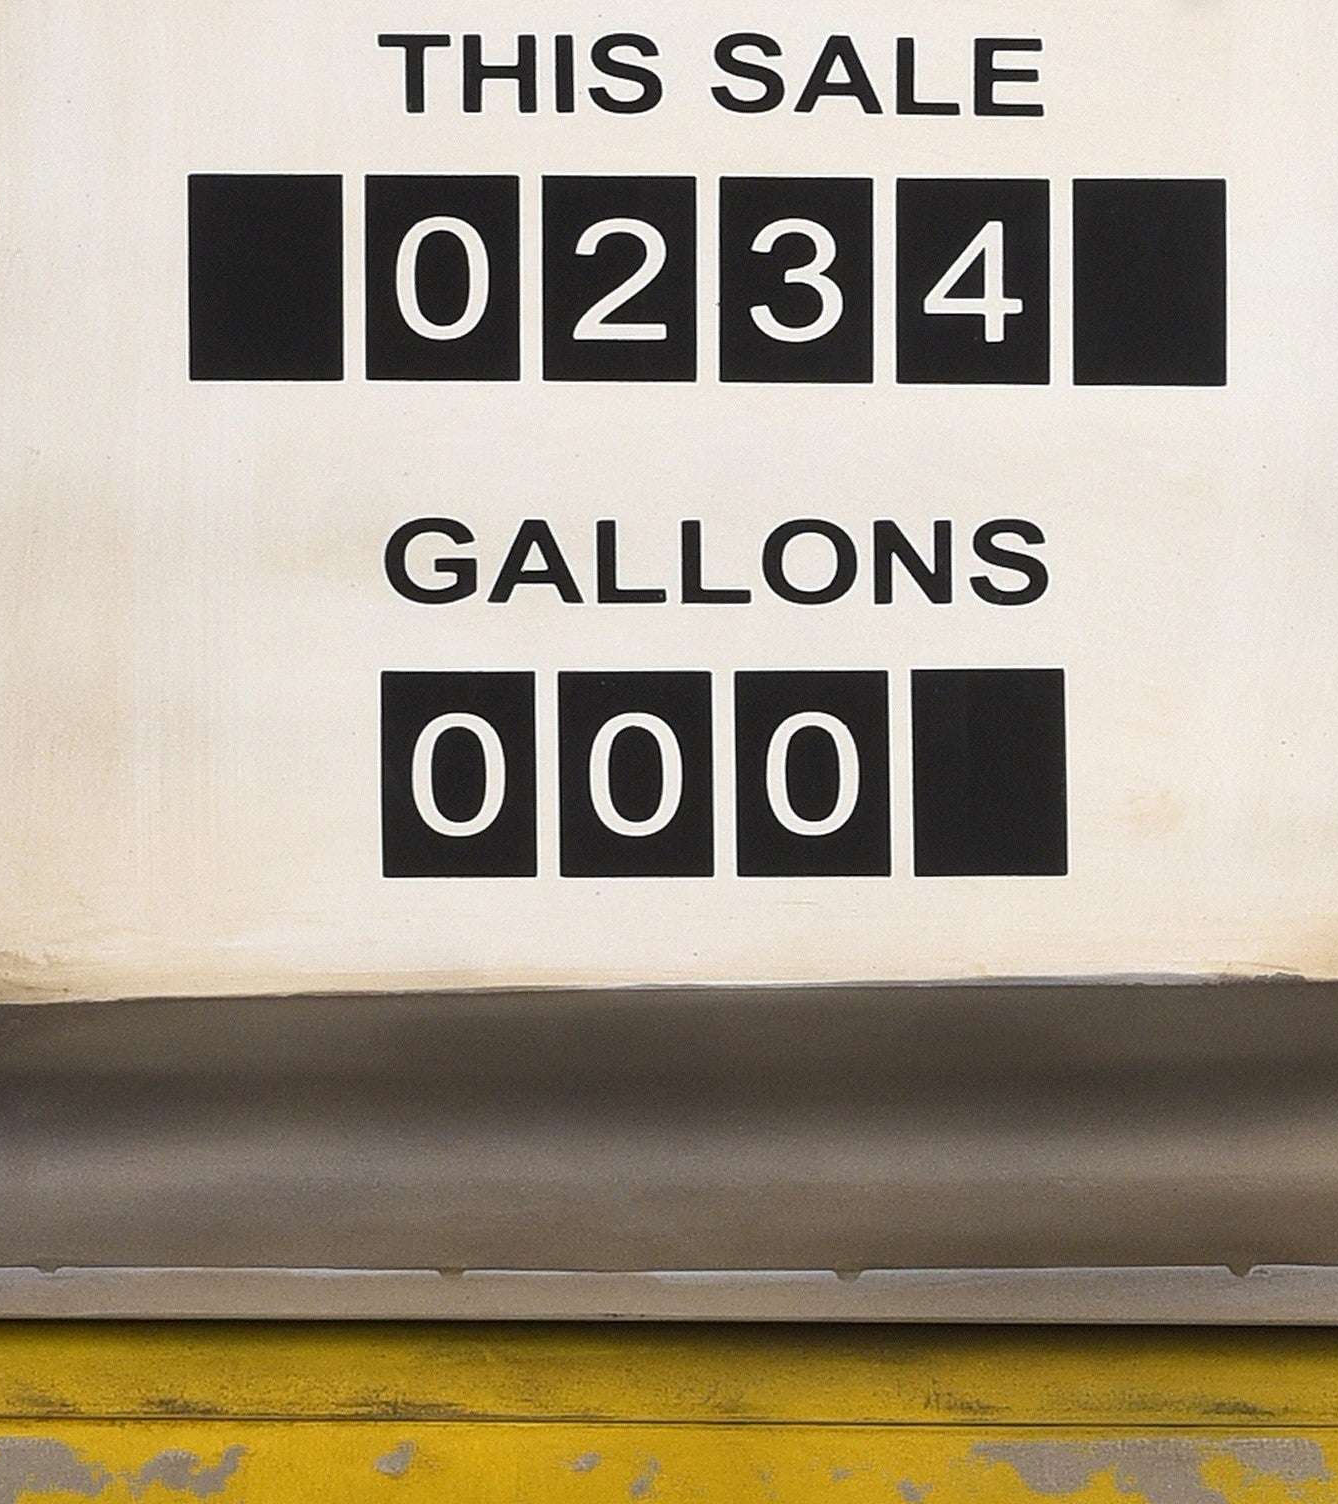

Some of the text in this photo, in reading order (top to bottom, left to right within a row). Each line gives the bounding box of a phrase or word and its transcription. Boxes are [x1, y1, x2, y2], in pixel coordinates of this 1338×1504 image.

[377, 33, 1046, 118] THIS SALE
[395, 216, 1025, 345] 0234
[384, 518, 1051, 607] GALLONS
[411, 712, 862, 839] 000
